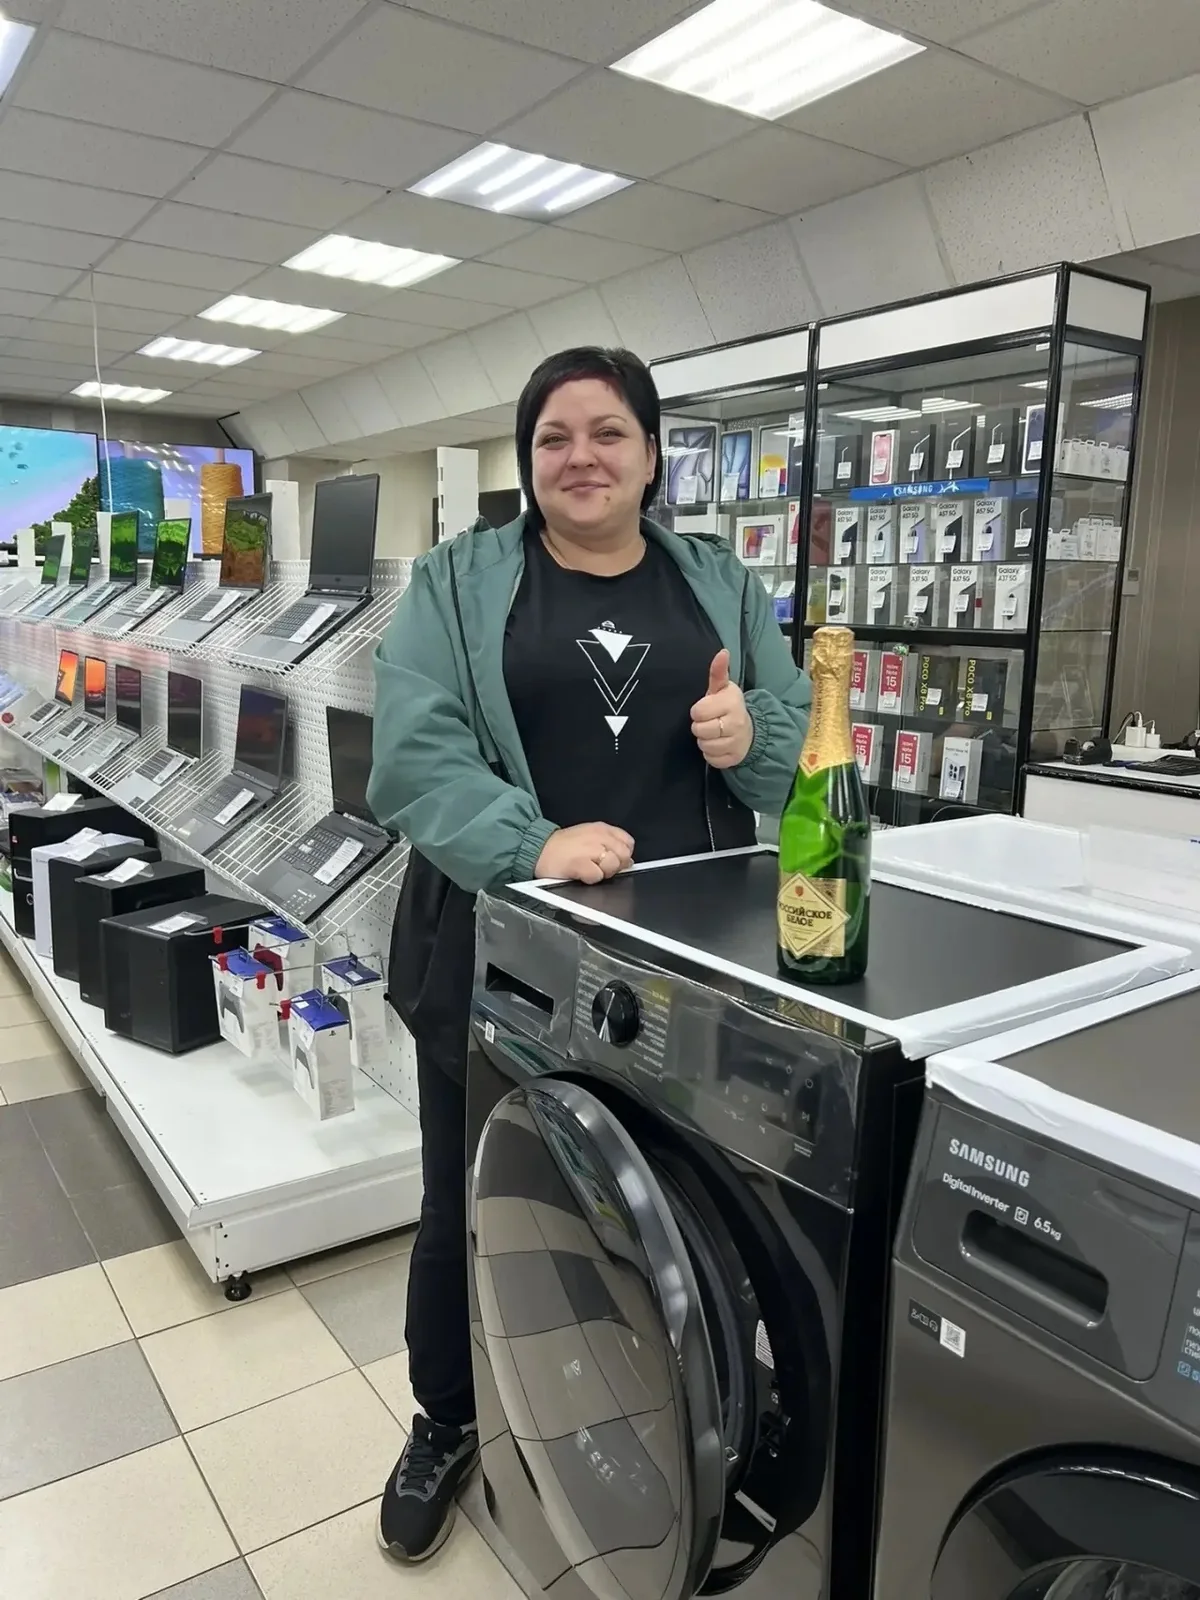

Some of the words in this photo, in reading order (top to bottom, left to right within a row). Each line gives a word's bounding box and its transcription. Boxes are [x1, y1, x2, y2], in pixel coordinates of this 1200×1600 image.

[894, 484, 933, 497] SAMSUNG
[922, 656, 930, 680] POCO
[967, 659, 976, 684] POCO
[886, 676, 896, 687] 15
[964, 700, 972, 716] Pro
[856, 745, 866, 755] 15
[901, 752, 912, 764] 15
[787, 914, 814, 926] БЕЛОЕ
[949, 1138, 1030, 1188] SAMSUNG
